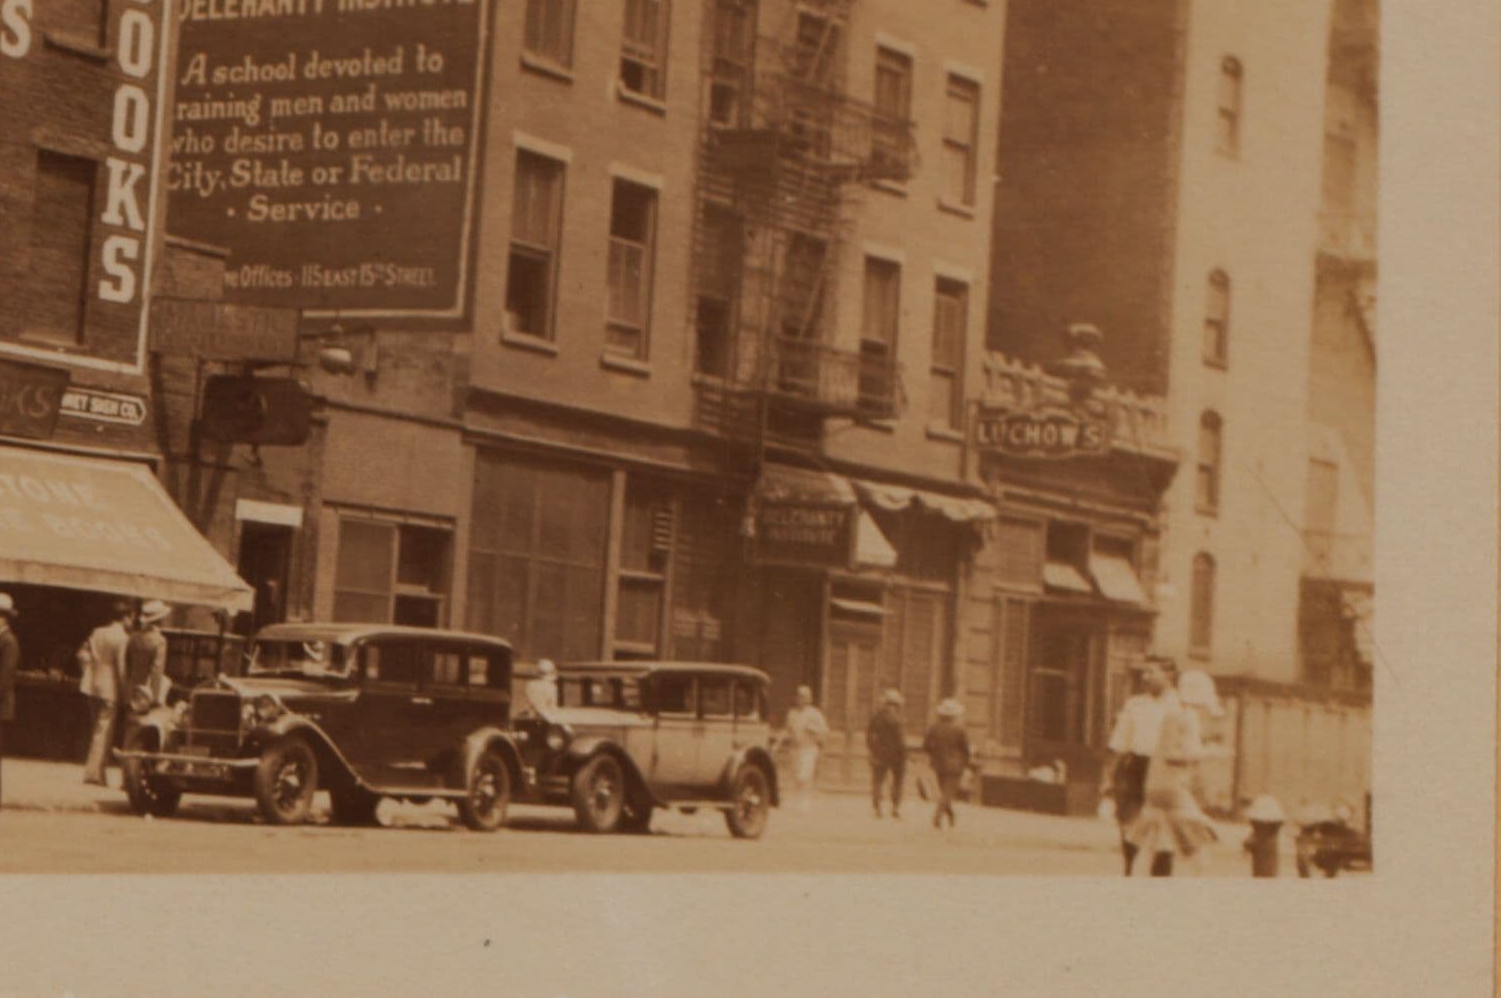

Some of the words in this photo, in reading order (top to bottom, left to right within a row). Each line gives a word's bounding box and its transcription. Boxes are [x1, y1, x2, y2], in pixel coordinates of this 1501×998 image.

[181, 52, 207, 86] A
[212, 52, 297, 85] school
[303, 46, 404, 81] devoted
[416, 42, 444, 75] to
[270, 95, 324, 118] men
[329, 83, 376, 113] and
[385, 89, 469, 110] women
[224, 126, 304, 154] desire
[312, 121, 340, 150] to
[348, 119, 414, 149] enter
[424, 117, 466, 146] the
[229, 158, 304, 188] State
[311, 166, 344, 186] or
[348, 155, 464, 186] Federal
[247, 193, 361, 223] Service
